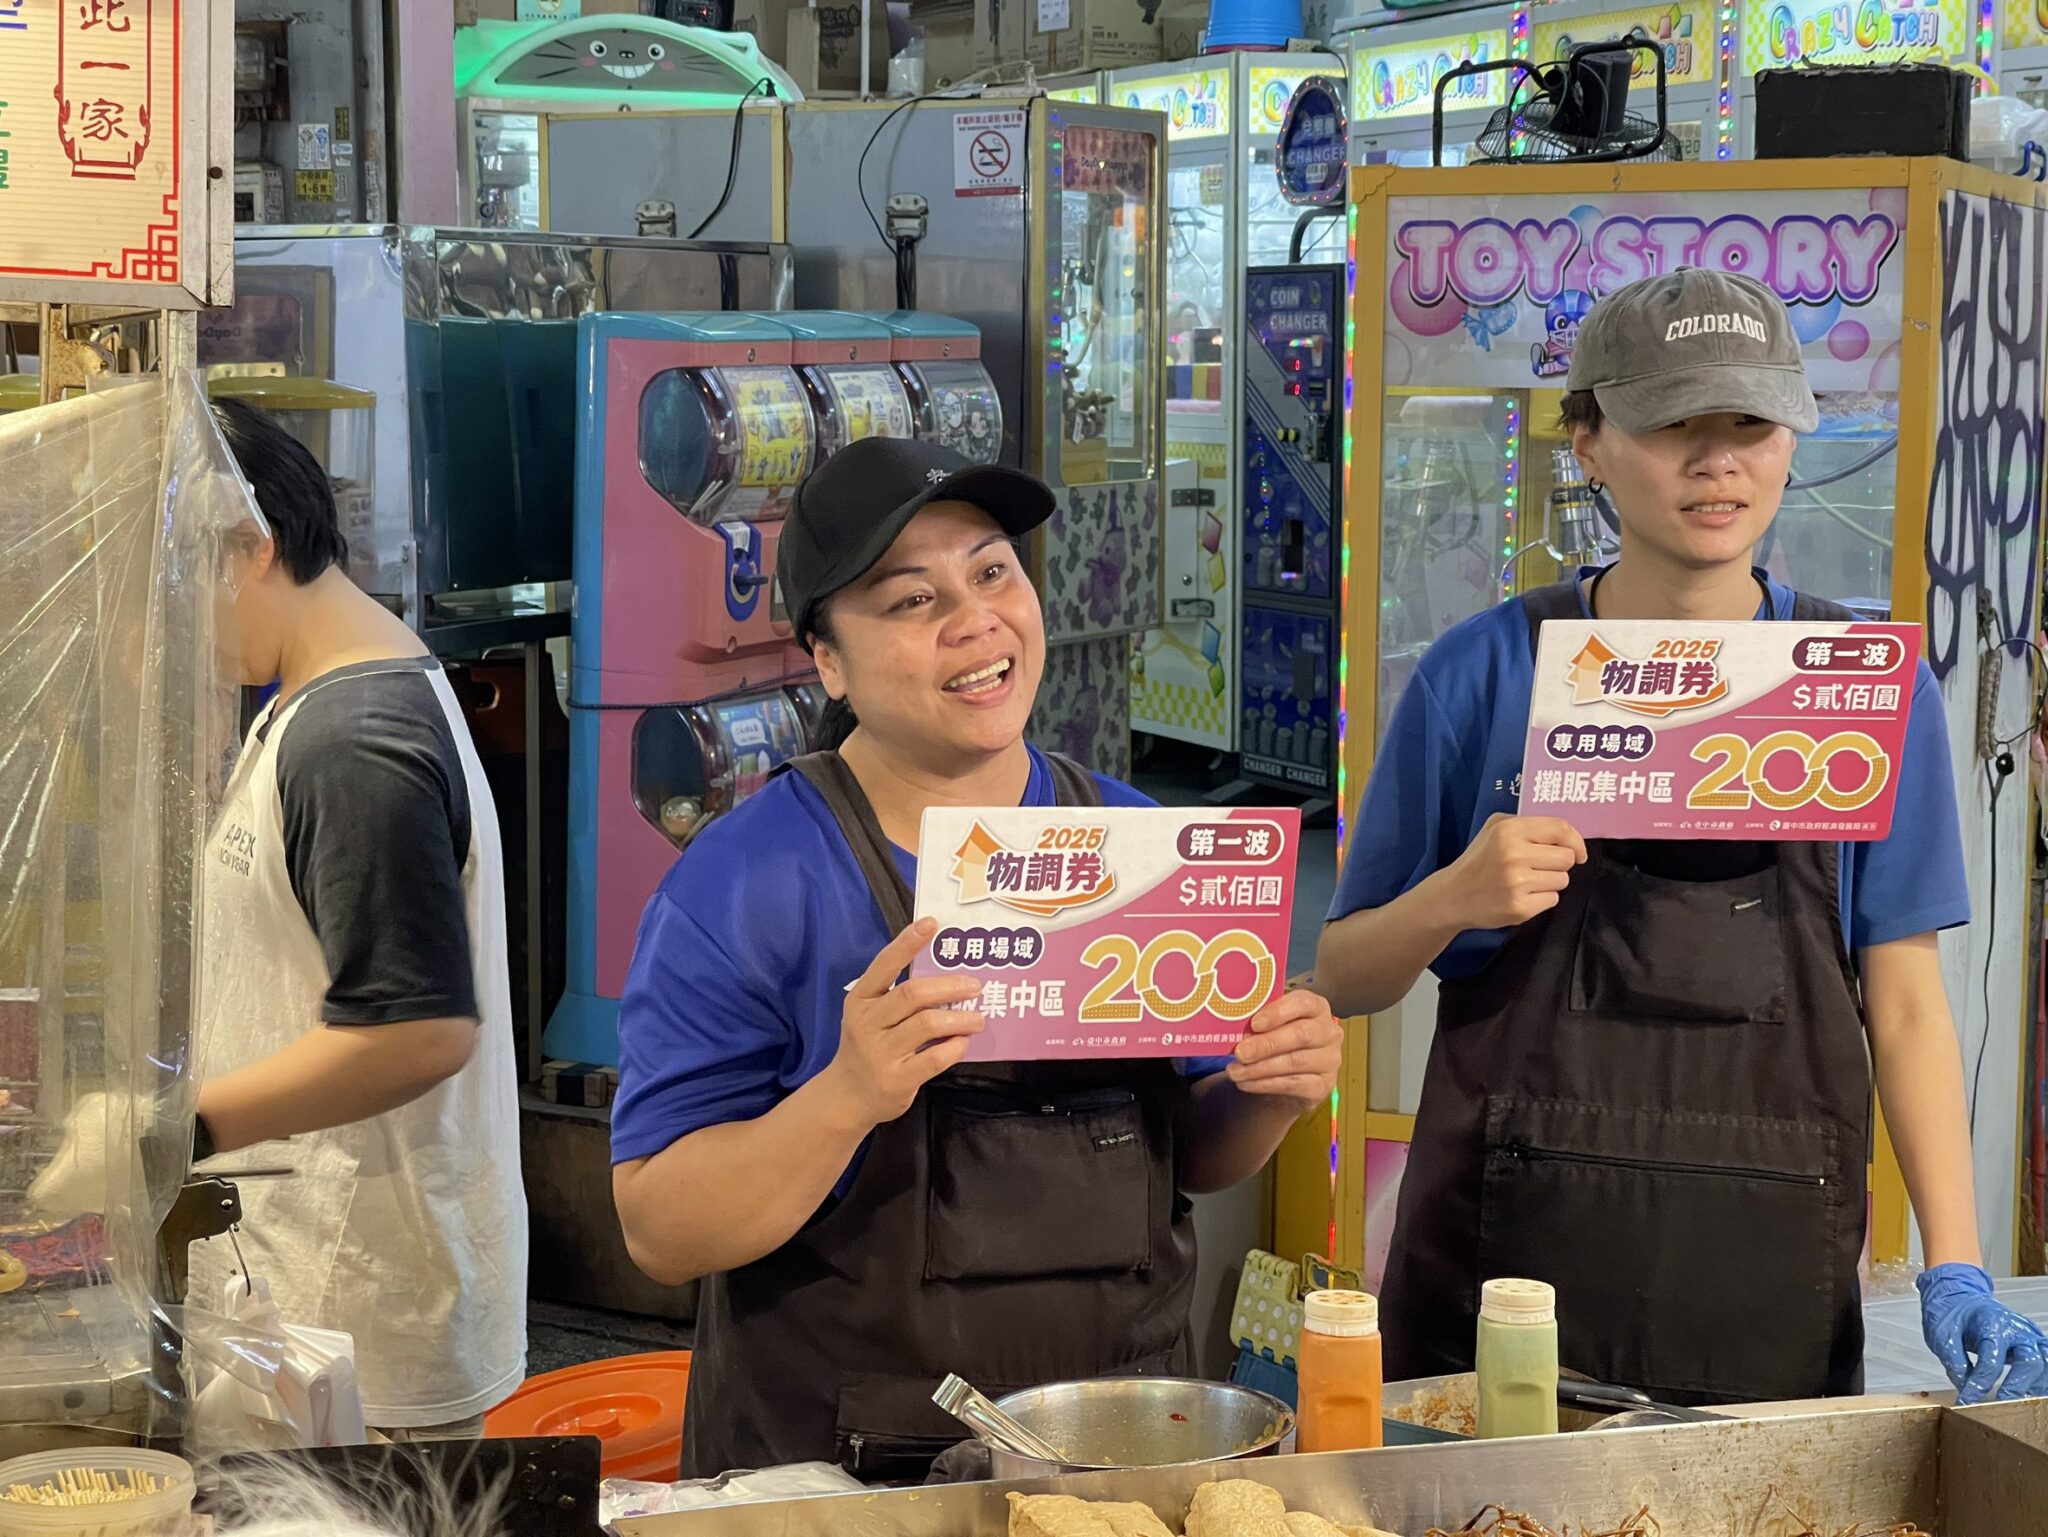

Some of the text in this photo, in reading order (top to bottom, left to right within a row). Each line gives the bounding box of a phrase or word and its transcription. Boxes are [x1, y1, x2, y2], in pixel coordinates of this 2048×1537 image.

[1396, 213, 1898, 306] TOY STORY
[1271, 288, 1299, 307] COIN
[1271, 313, 1328, 332] CHANGER
[1664, 312, 1767, 343] COLORADO
[1651, 640, 1719, 659] 2025
[1804, 641, 1890, 667] 第一波
[1600, 660, 1715, 696] 物調券
[1792, 683, 1901, 711] $貳佰圓
[1552, 732, 1647, 754] 專用場域
[1686, 730, 1890, 811] 200
[1532, 769, 1676, 804] 攤販集中區
[1037, 828, 1104, 849] 2025
[1189, 828, 1270, 857] 第一波
[986, 852, 1102, 892] 物調券
[1179, 875, 1283, 906] $貳佰圓
[939, 937, 1035, 960] 專用場域
[1079, 928, 1276, 1023] 200
